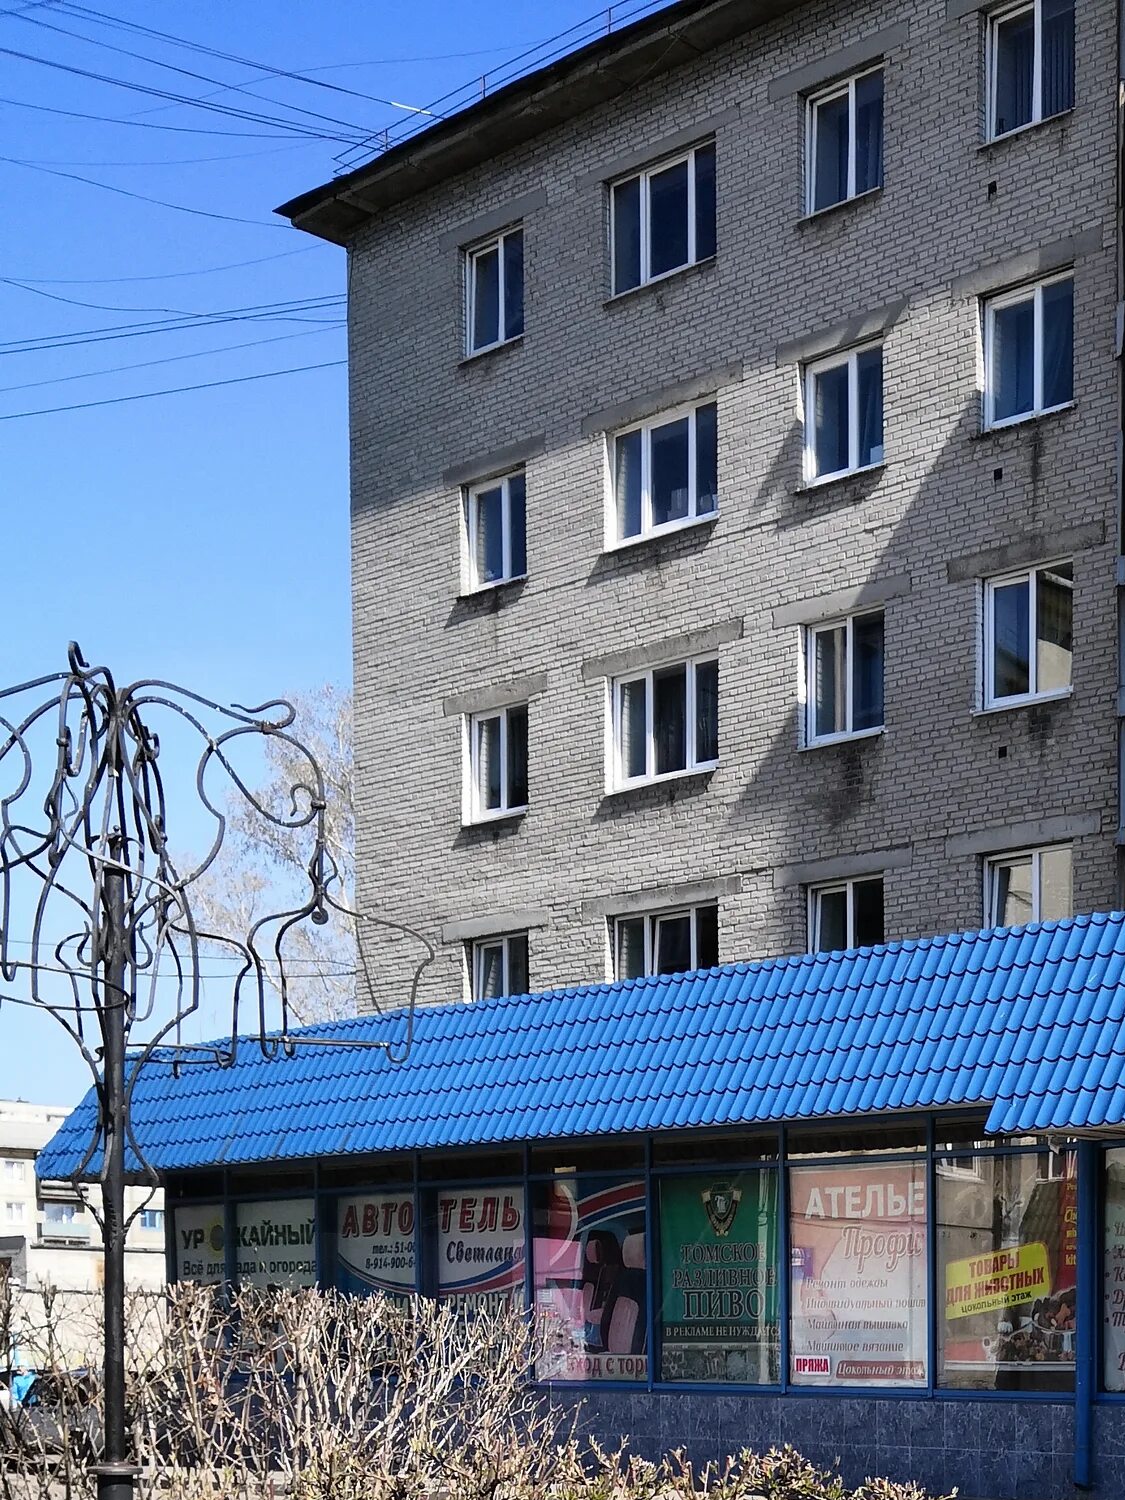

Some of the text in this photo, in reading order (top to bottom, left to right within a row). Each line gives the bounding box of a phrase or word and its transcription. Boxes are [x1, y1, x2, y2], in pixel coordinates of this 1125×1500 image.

[804, 1181, 925, 1220] АТЕЛЬЕ
[446, 1240, 523, 1264] Светлана
[680, 1243, 767, 1264] ТОМСКОЕ
[365, 1257, 416, 1270] 8-914-900-6
[968, 1252, 1020, 1280] ТОВАРЫ
[672, 1268, 777, 1289] РАЗЛИВНОЕ
[682, 1289, 766, 1320] ПИВО
[946, 1284, 973, 1307] ДЛЯ
[1011, 1291, 1032, 1303] этаж
[673, 1326, 714, 1337] РЕКЛАМЕ
[715, 1326, 726, 1337] НЕ
[617, 1356, 648, 1378] тор
[795, 1357, 829, 1373] ПРЯЖА
[838, 1362, 894, 1377] Цокольный
